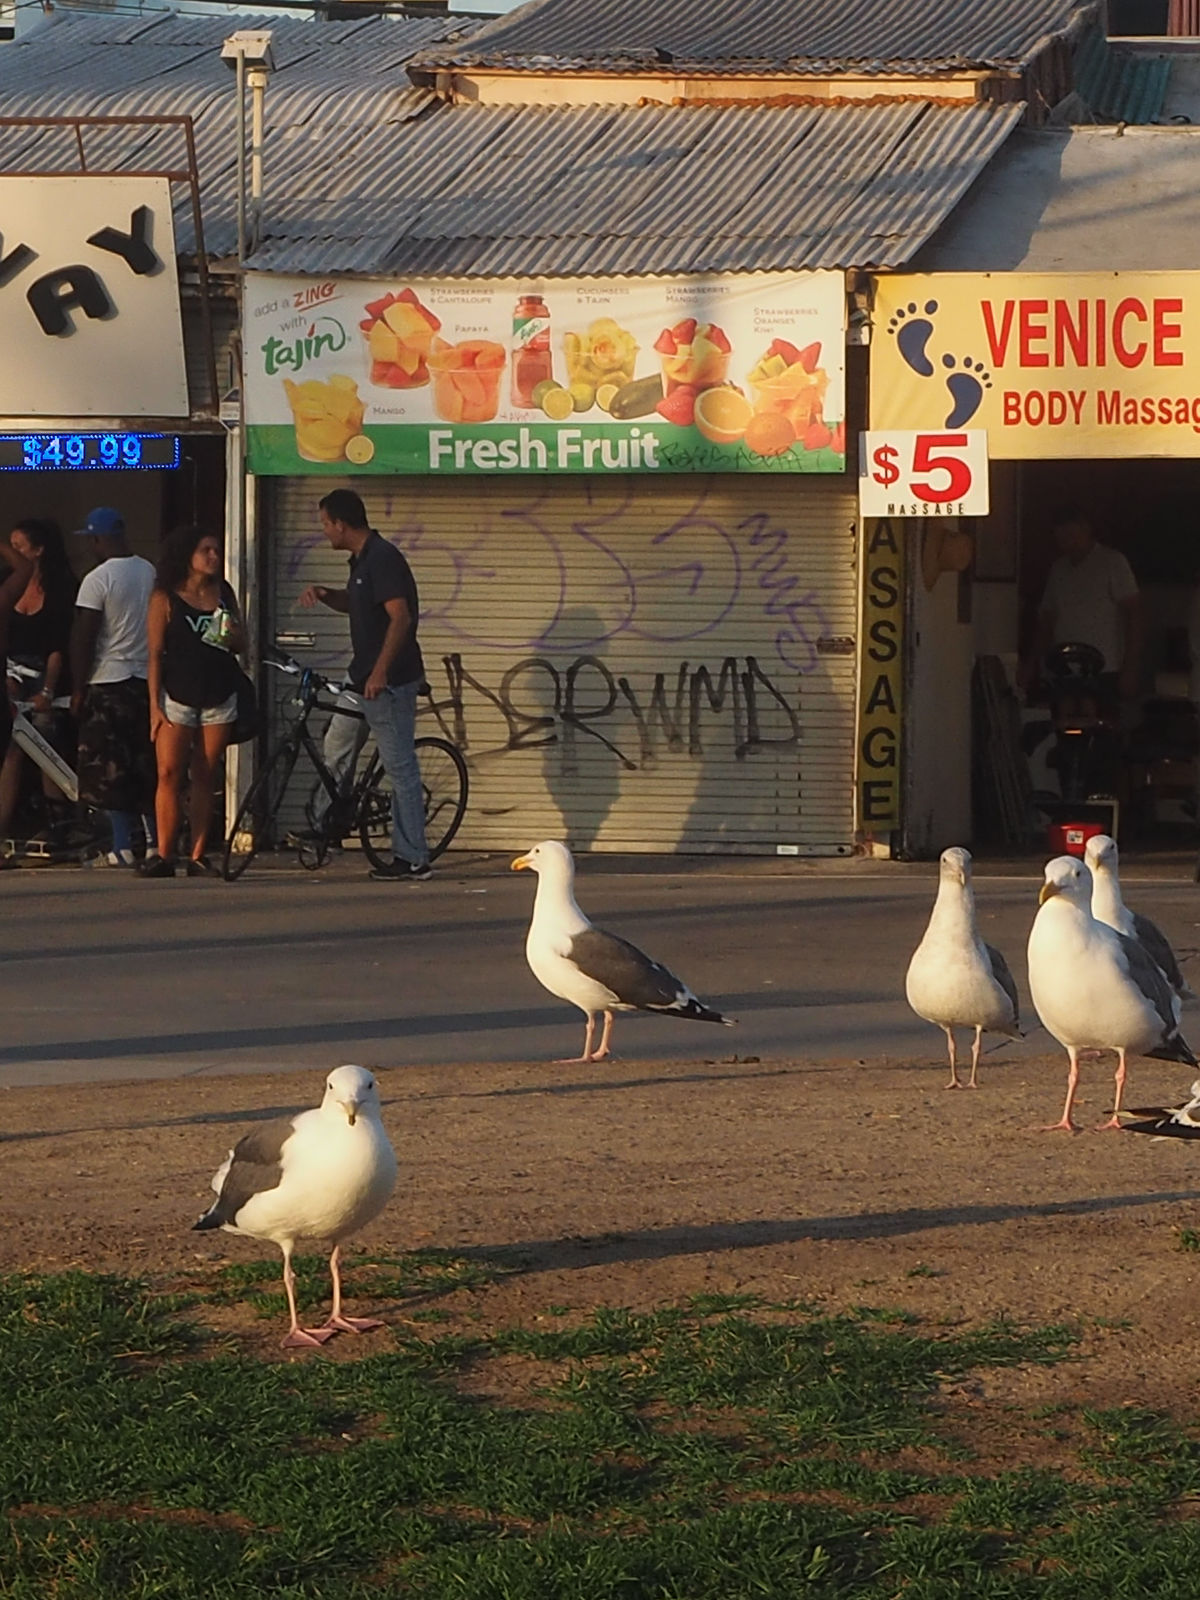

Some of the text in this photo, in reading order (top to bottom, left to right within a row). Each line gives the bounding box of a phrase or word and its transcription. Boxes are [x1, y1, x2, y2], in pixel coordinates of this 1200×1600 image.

[253, 282, 338, 319] add a ZING
[279, 316, 307, 332] with
[981, 298, 1184, 369] VENICE
[1003, 391, 1086, 426] BODY
[23, 436, 142, 469] $49.99
[428, 427, 547, 469] Fresh
[557, 427, 659, 469] Fruit
[887, 503, 966, 516] MASSAGE
[861, 518, 899, 822] ASSAGE
